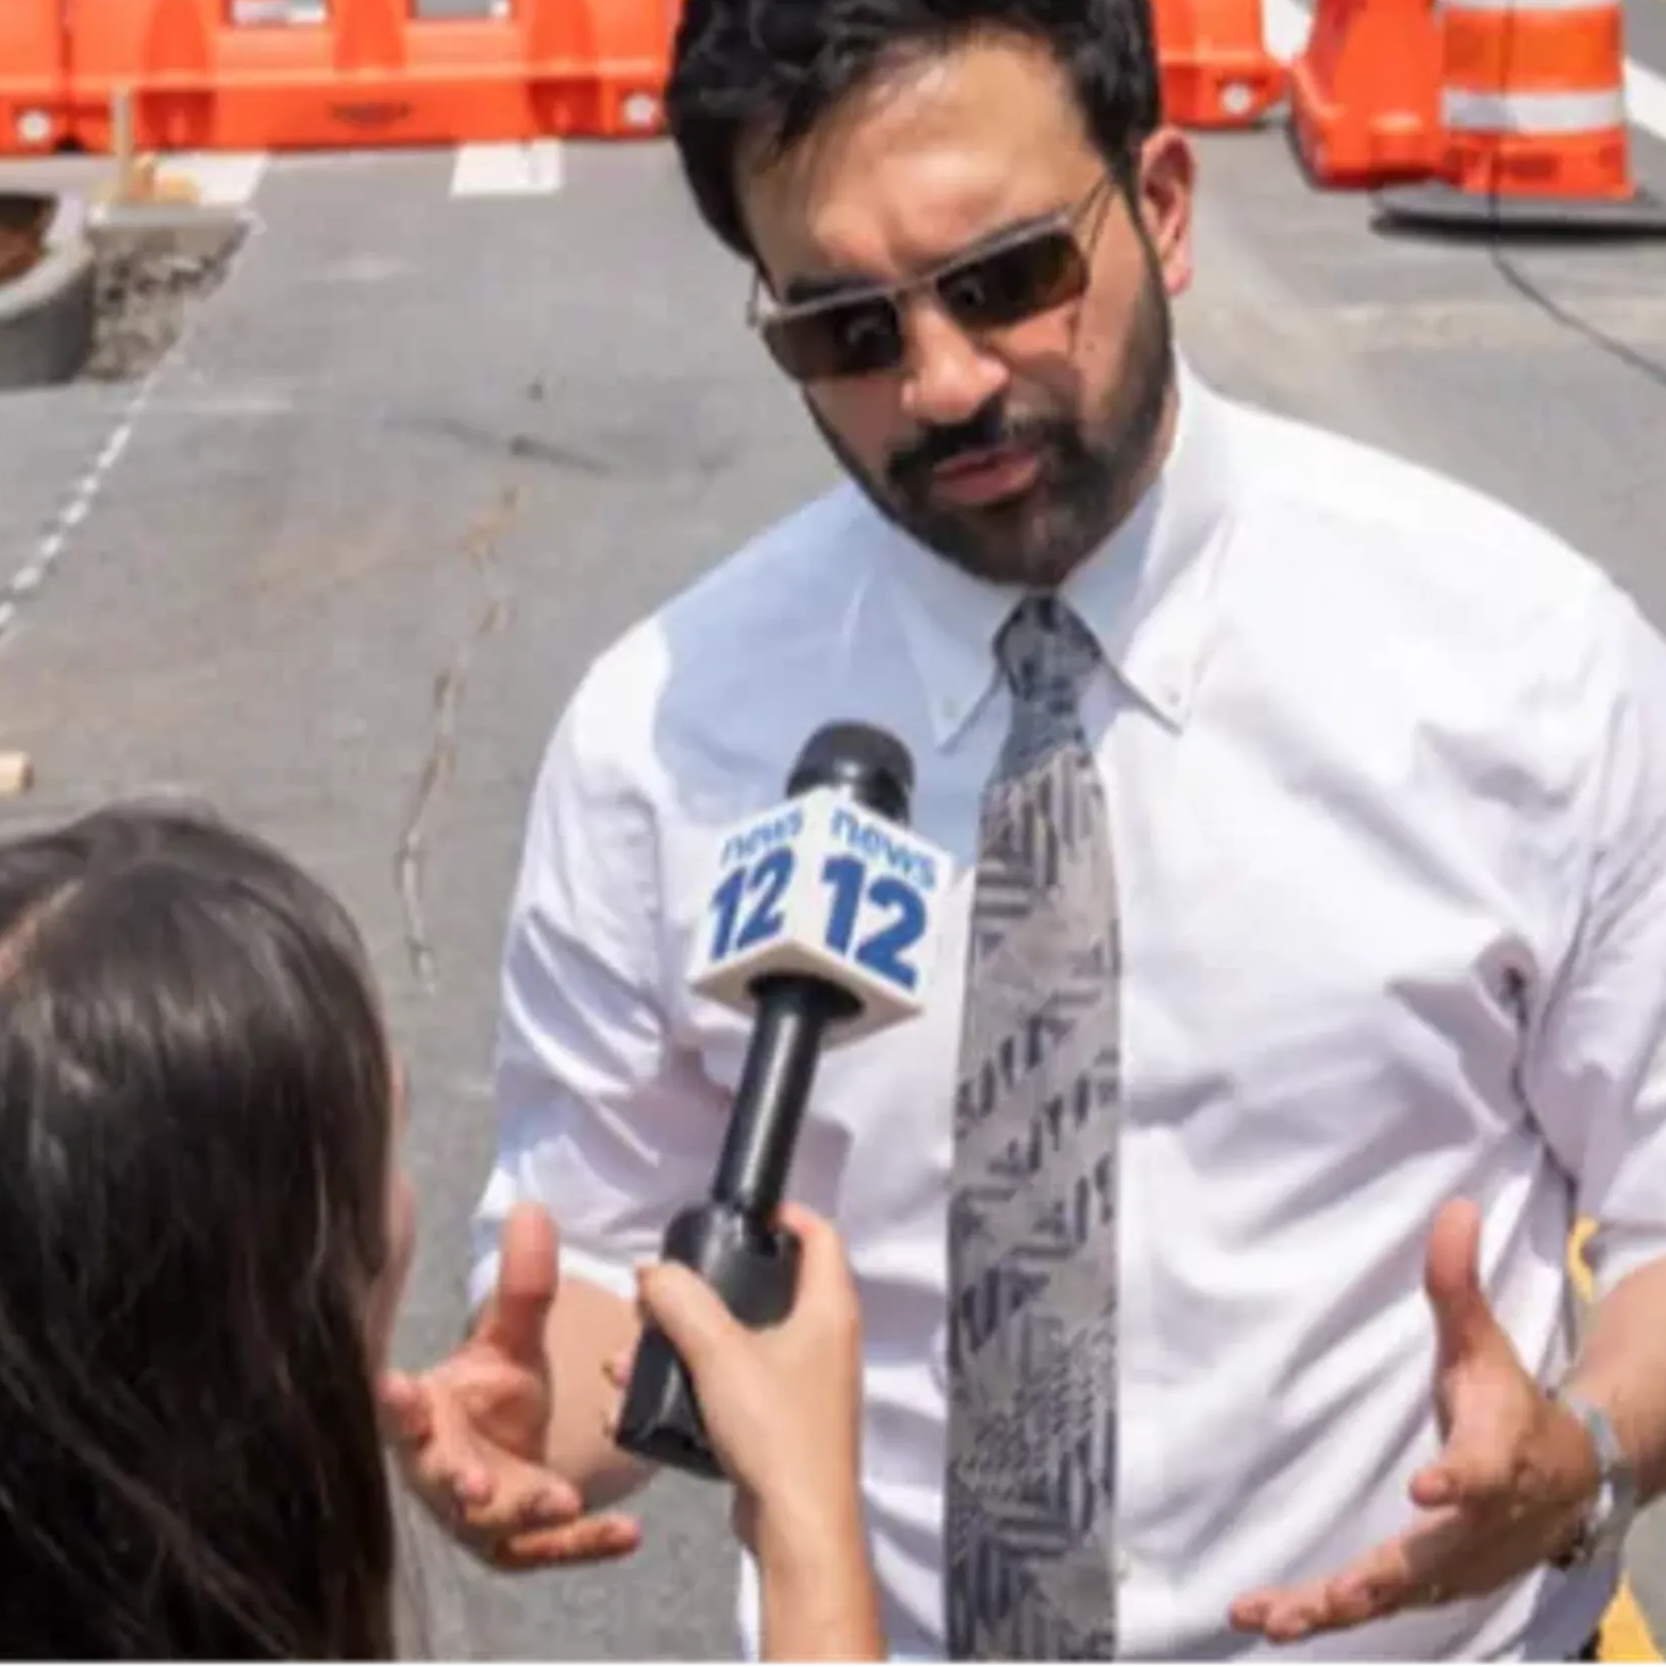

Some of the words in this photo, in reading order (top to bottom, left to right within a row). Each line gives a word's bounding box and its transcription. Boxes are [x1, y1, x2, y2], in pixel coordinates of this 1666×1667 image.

[709, 846, 794, 962] 12
[832, 809, 937, 890] news
[822, 855, 927, 992] 12
